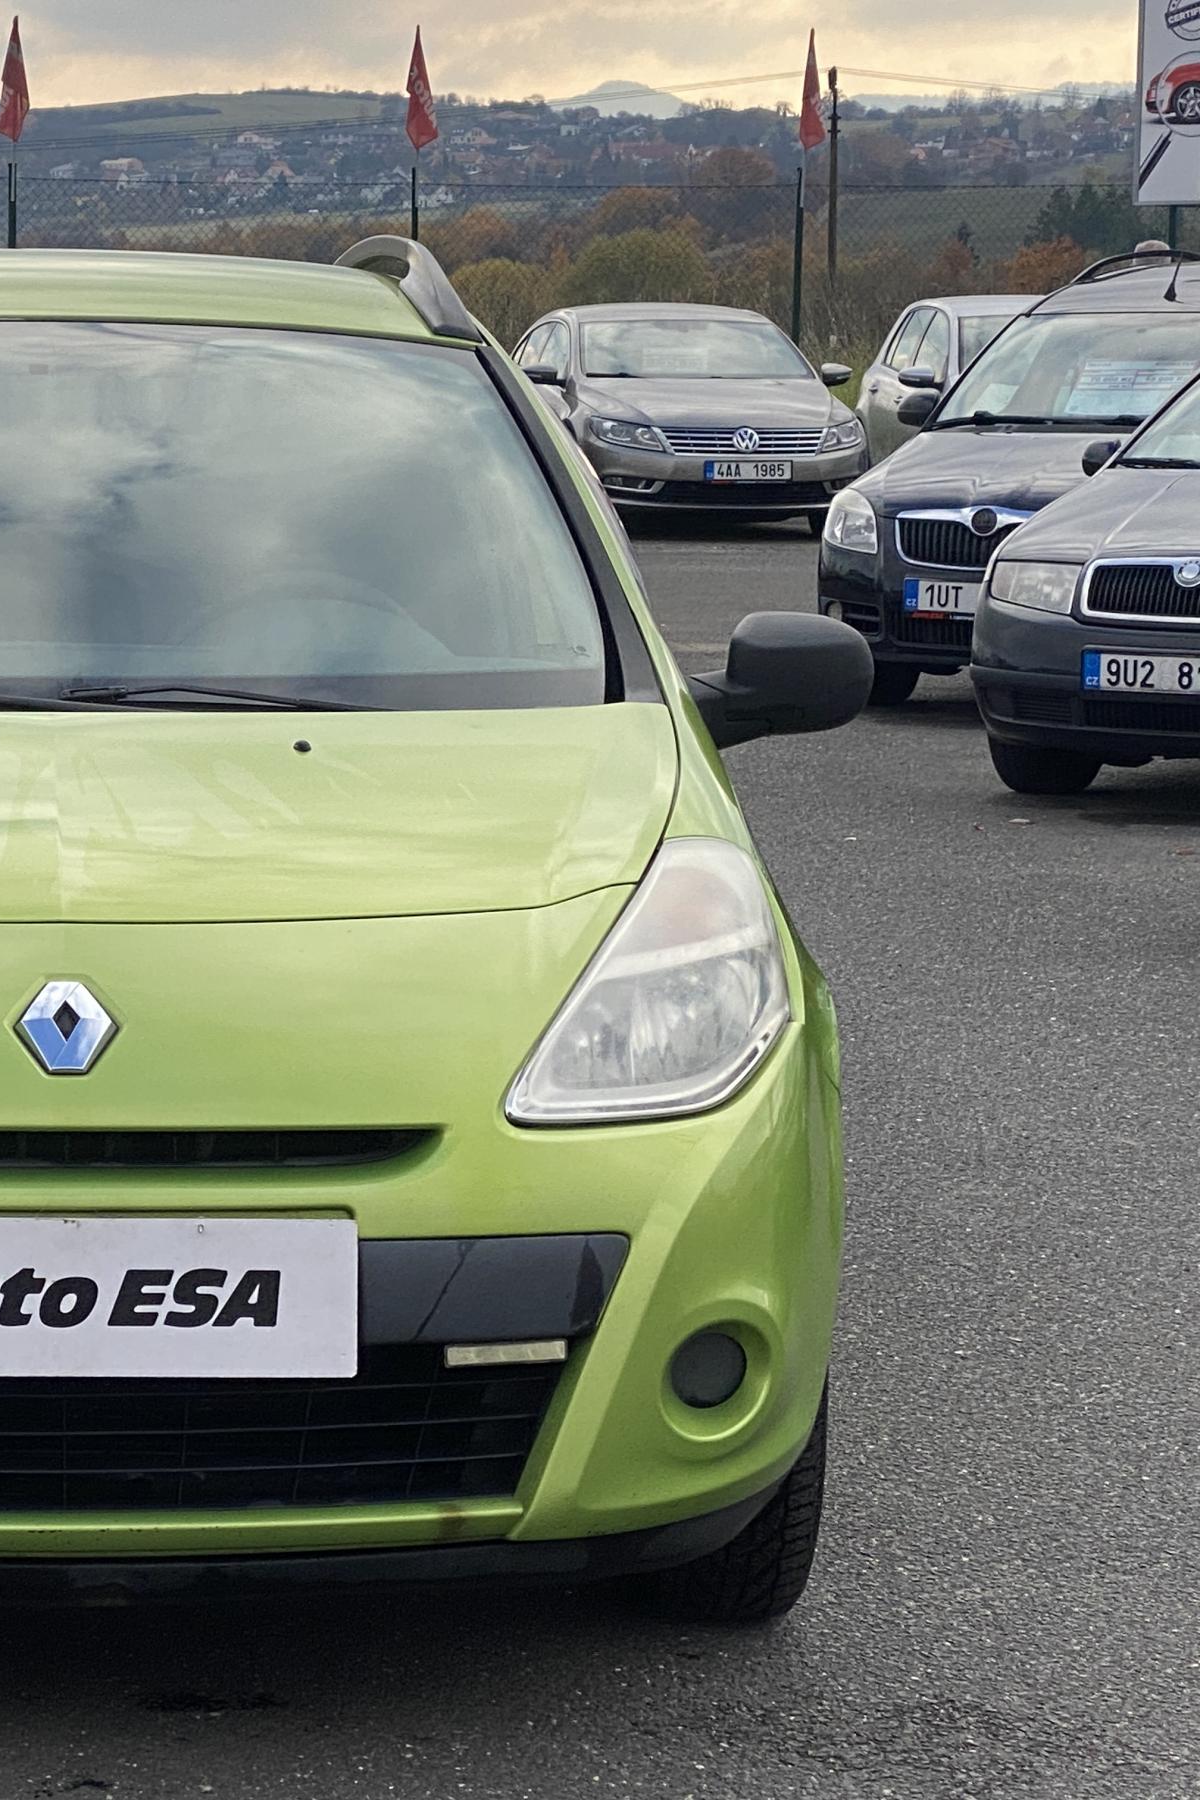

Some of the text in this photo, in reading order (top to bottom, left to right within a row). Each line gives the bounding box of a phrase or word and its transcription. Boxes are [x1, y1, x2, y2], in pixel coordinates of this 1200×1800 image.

[717, 463, 742, 477] 4AA
[753, 463, 785, 477] 1985
[906, 598, 917, 607] CZ
[925, 584, 963, 608] 1UT
[1086, 677, 1099, 686] CZ
[1107, 659, 1200, 689] 9U2 8
[107, 1268, 281, 1328] ESA
